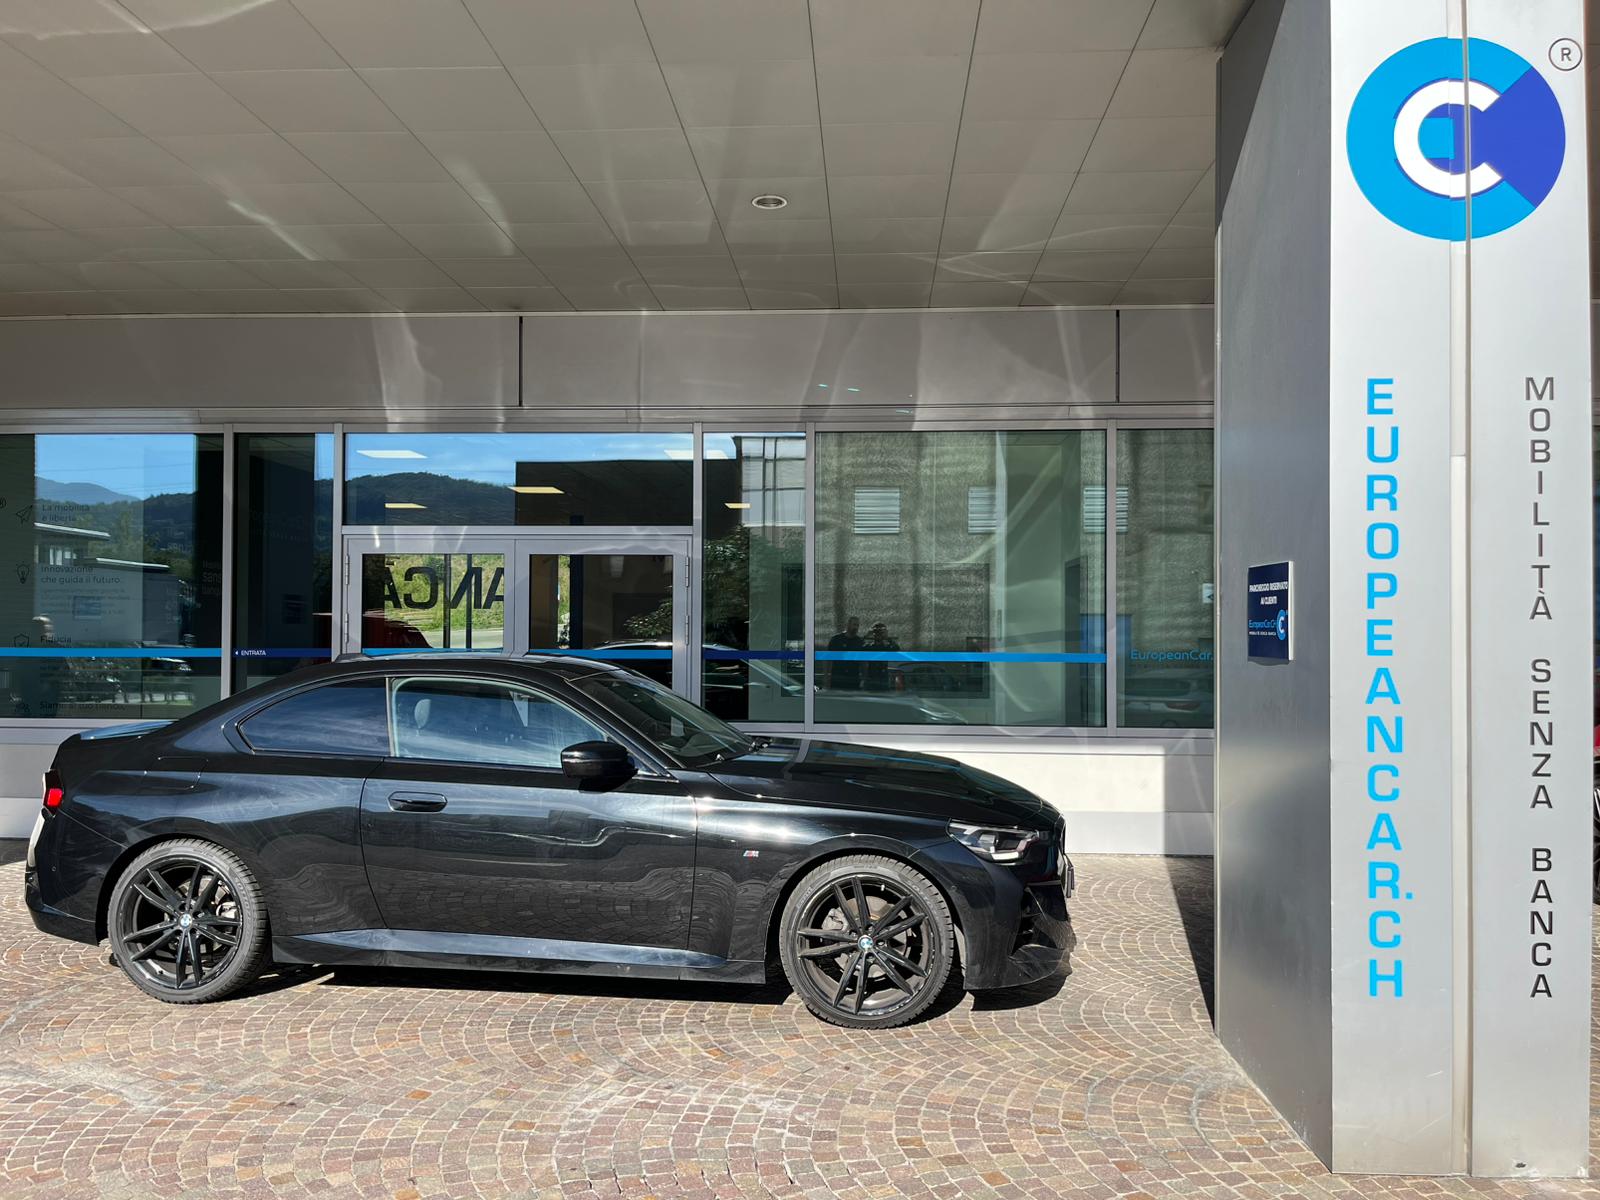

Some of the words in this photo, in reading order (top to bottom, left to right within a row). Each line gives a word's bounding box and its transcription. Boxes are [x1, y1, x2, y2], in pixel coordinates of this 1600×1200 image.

[41, 565, 94, 573] Innovazione
[1525, 376, 1554, 620] MOBILITÀ
[40, 576, 56, 584] che
[59, 576, 83, 585] guida
[93, 576, 121, 584] futuro
[1365, 378, 1413, 998] EUROPEANCAR.CH
[1529, 658, 1553, 809] SENZA
[1529, 847, 1553, 998] BANCA
